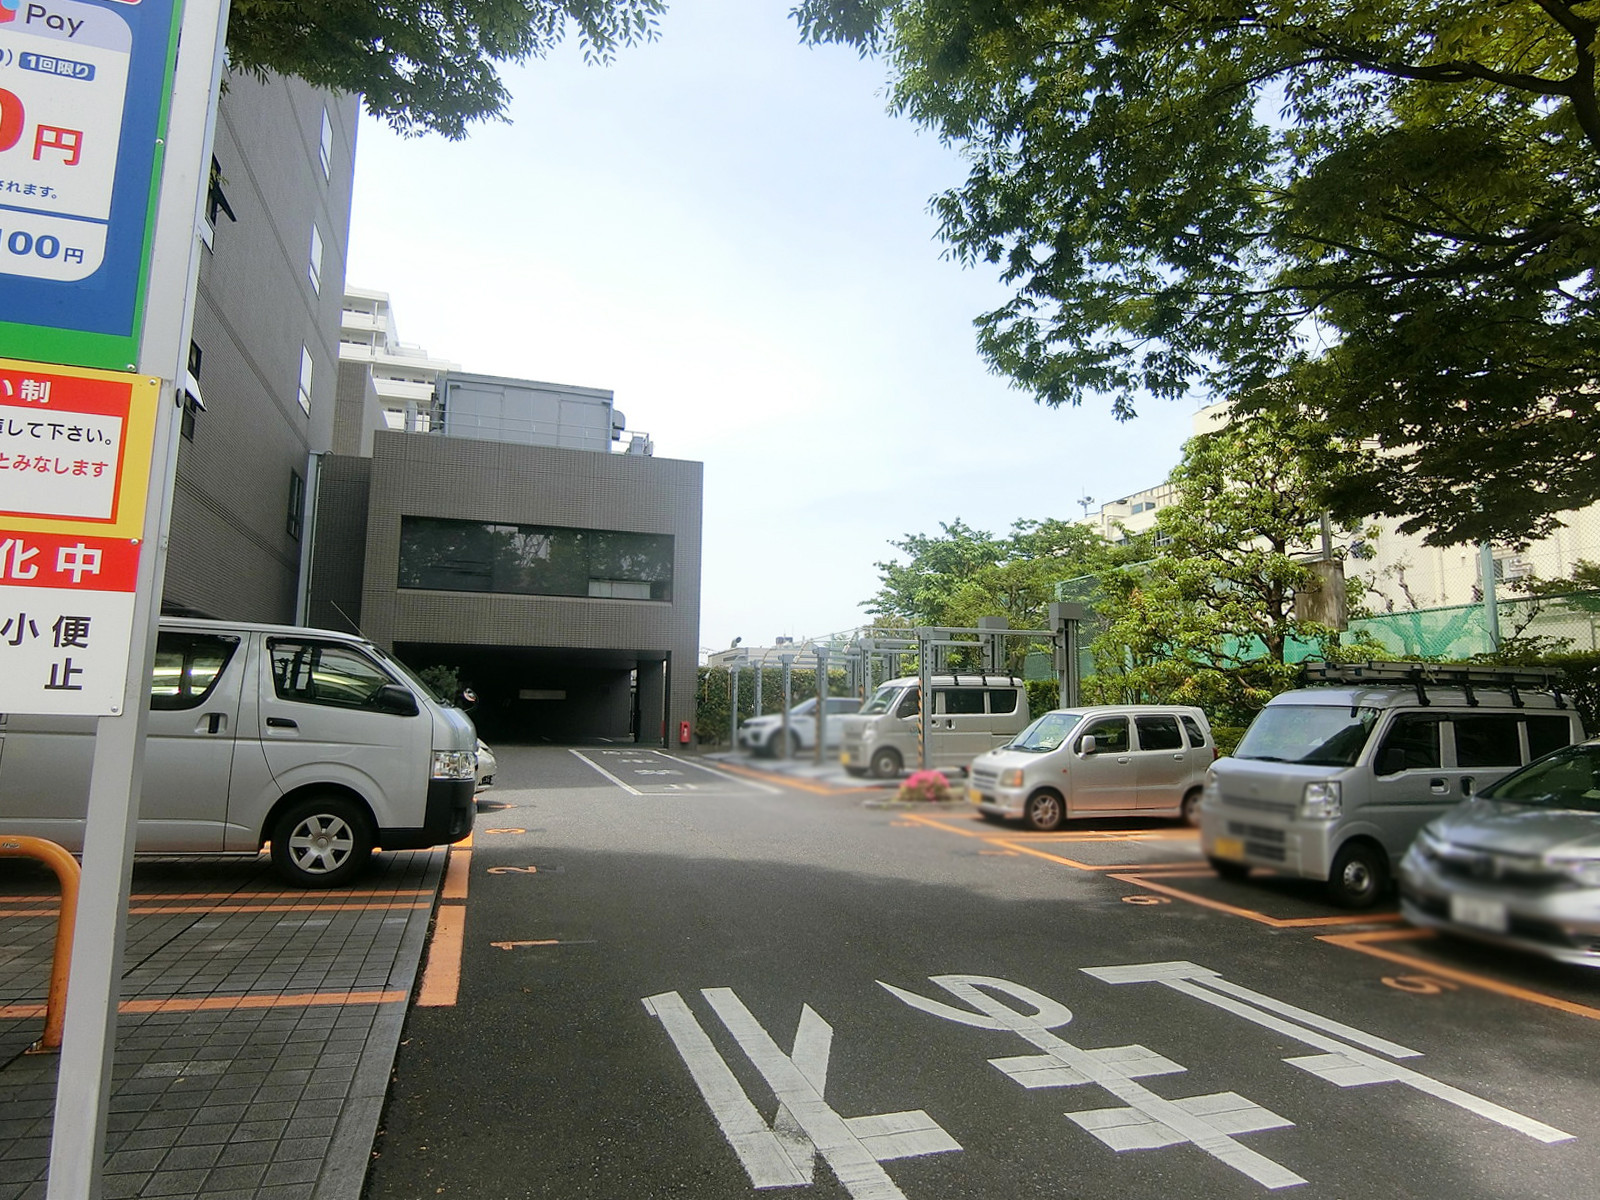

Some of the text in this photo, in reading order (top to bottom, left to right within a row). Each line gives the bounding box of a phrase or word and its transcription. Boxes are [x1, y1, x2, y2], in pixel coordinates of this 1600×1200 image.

[26, 3, 84, 38] Pay
[27, 55, 89, 78] 1回限り
[0, 180, 57, 199] れます。
[0, 229, 84, 264] 00円
[0, 452, 108, 478] とみなします
[0, 538, 103, 583] 化中
[0, 612, 91, 649] 小便
[44, 657, 83, 690] 止
[487, 865, 537, 873] 2
